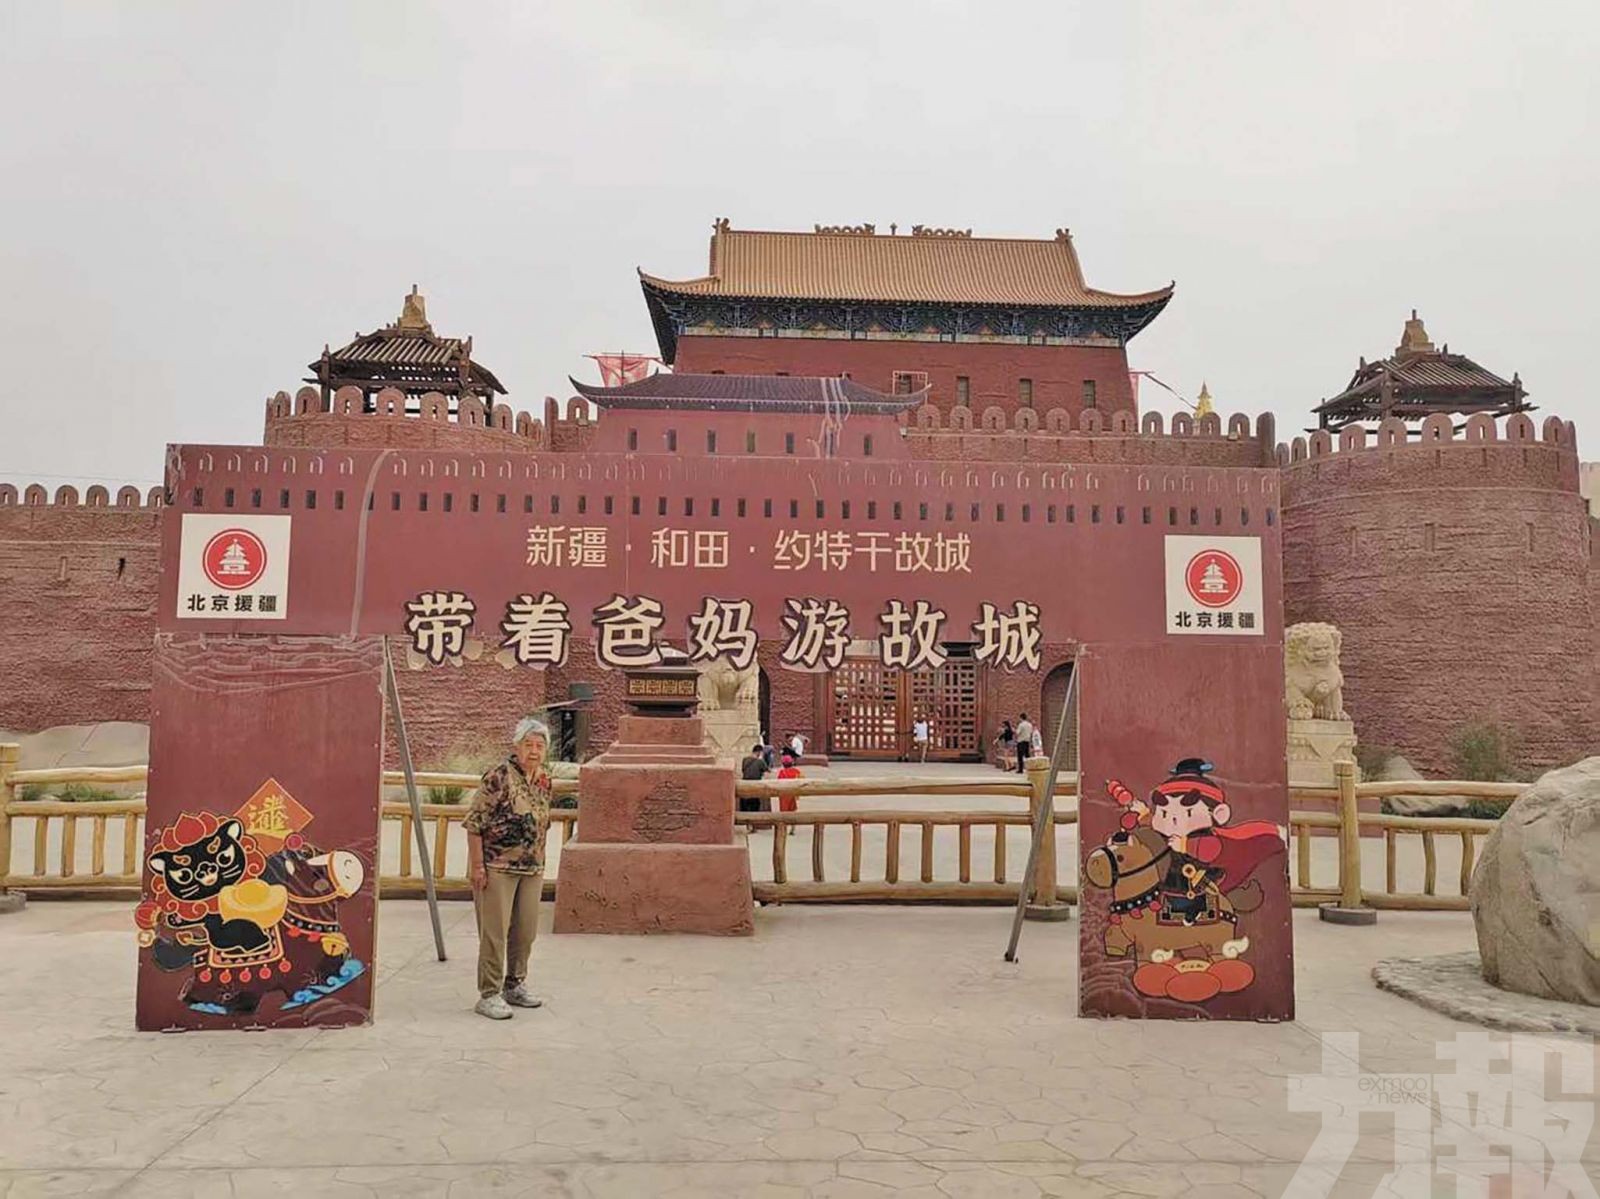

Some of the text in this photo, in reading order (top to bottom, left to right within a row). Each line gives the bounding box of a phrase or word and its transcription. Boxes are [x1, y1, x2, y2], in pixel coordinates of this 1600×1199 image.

[187, 594, 277, 612] 北京援疆
[1175, 611, 1254, 628] 北京援疆
[406, 592, 1041, 669] 带着爸妈游故城
